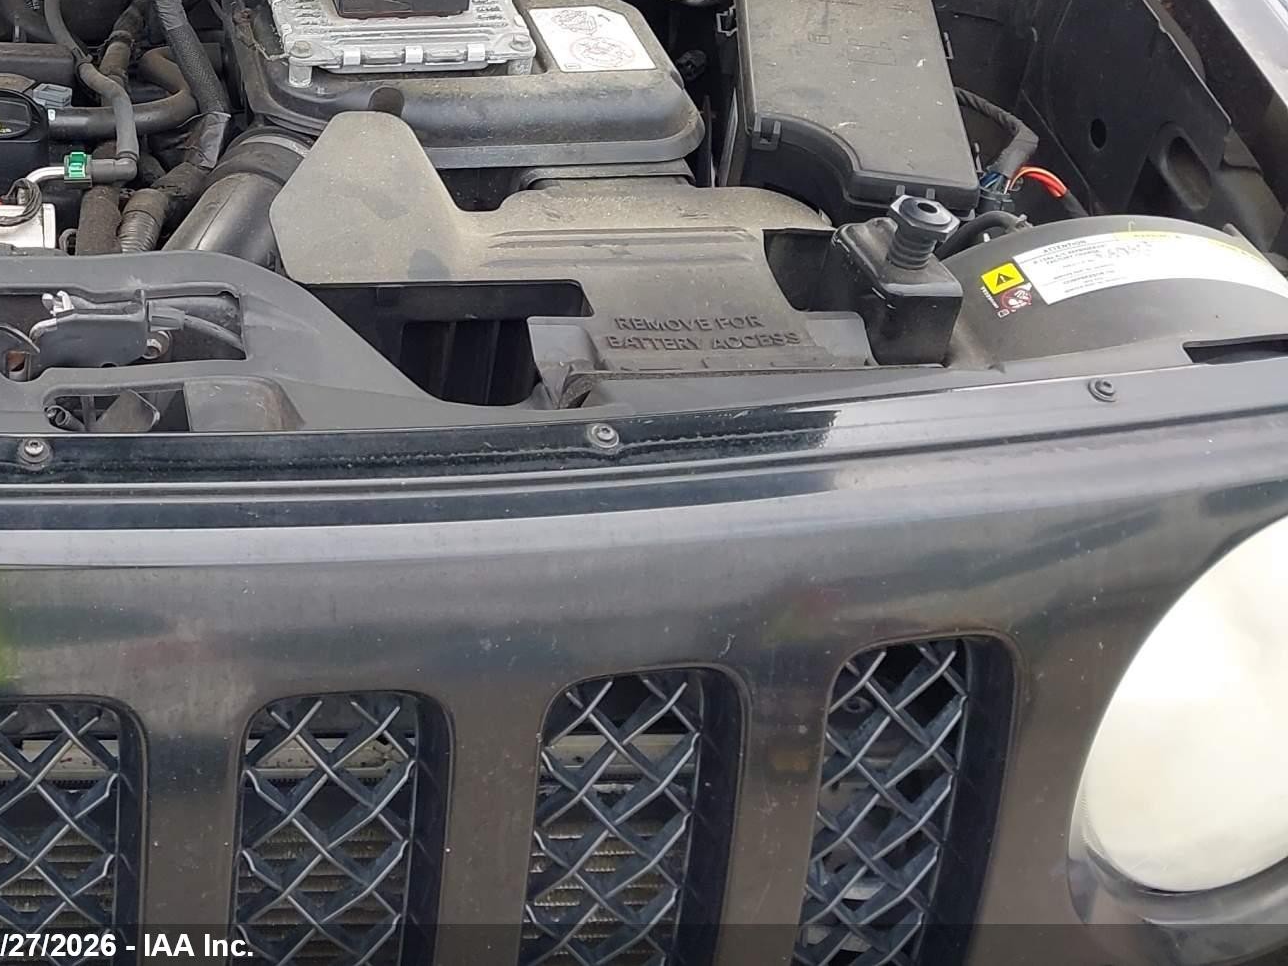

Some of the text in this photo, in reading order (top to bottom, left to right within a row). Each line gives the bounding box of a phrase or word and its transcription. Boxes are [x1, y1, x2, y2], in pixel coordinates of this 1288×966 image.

[614, 315, 765, 331] REMOVE FOR
[606, 332, 801, 351] BATTERY ACCESS
